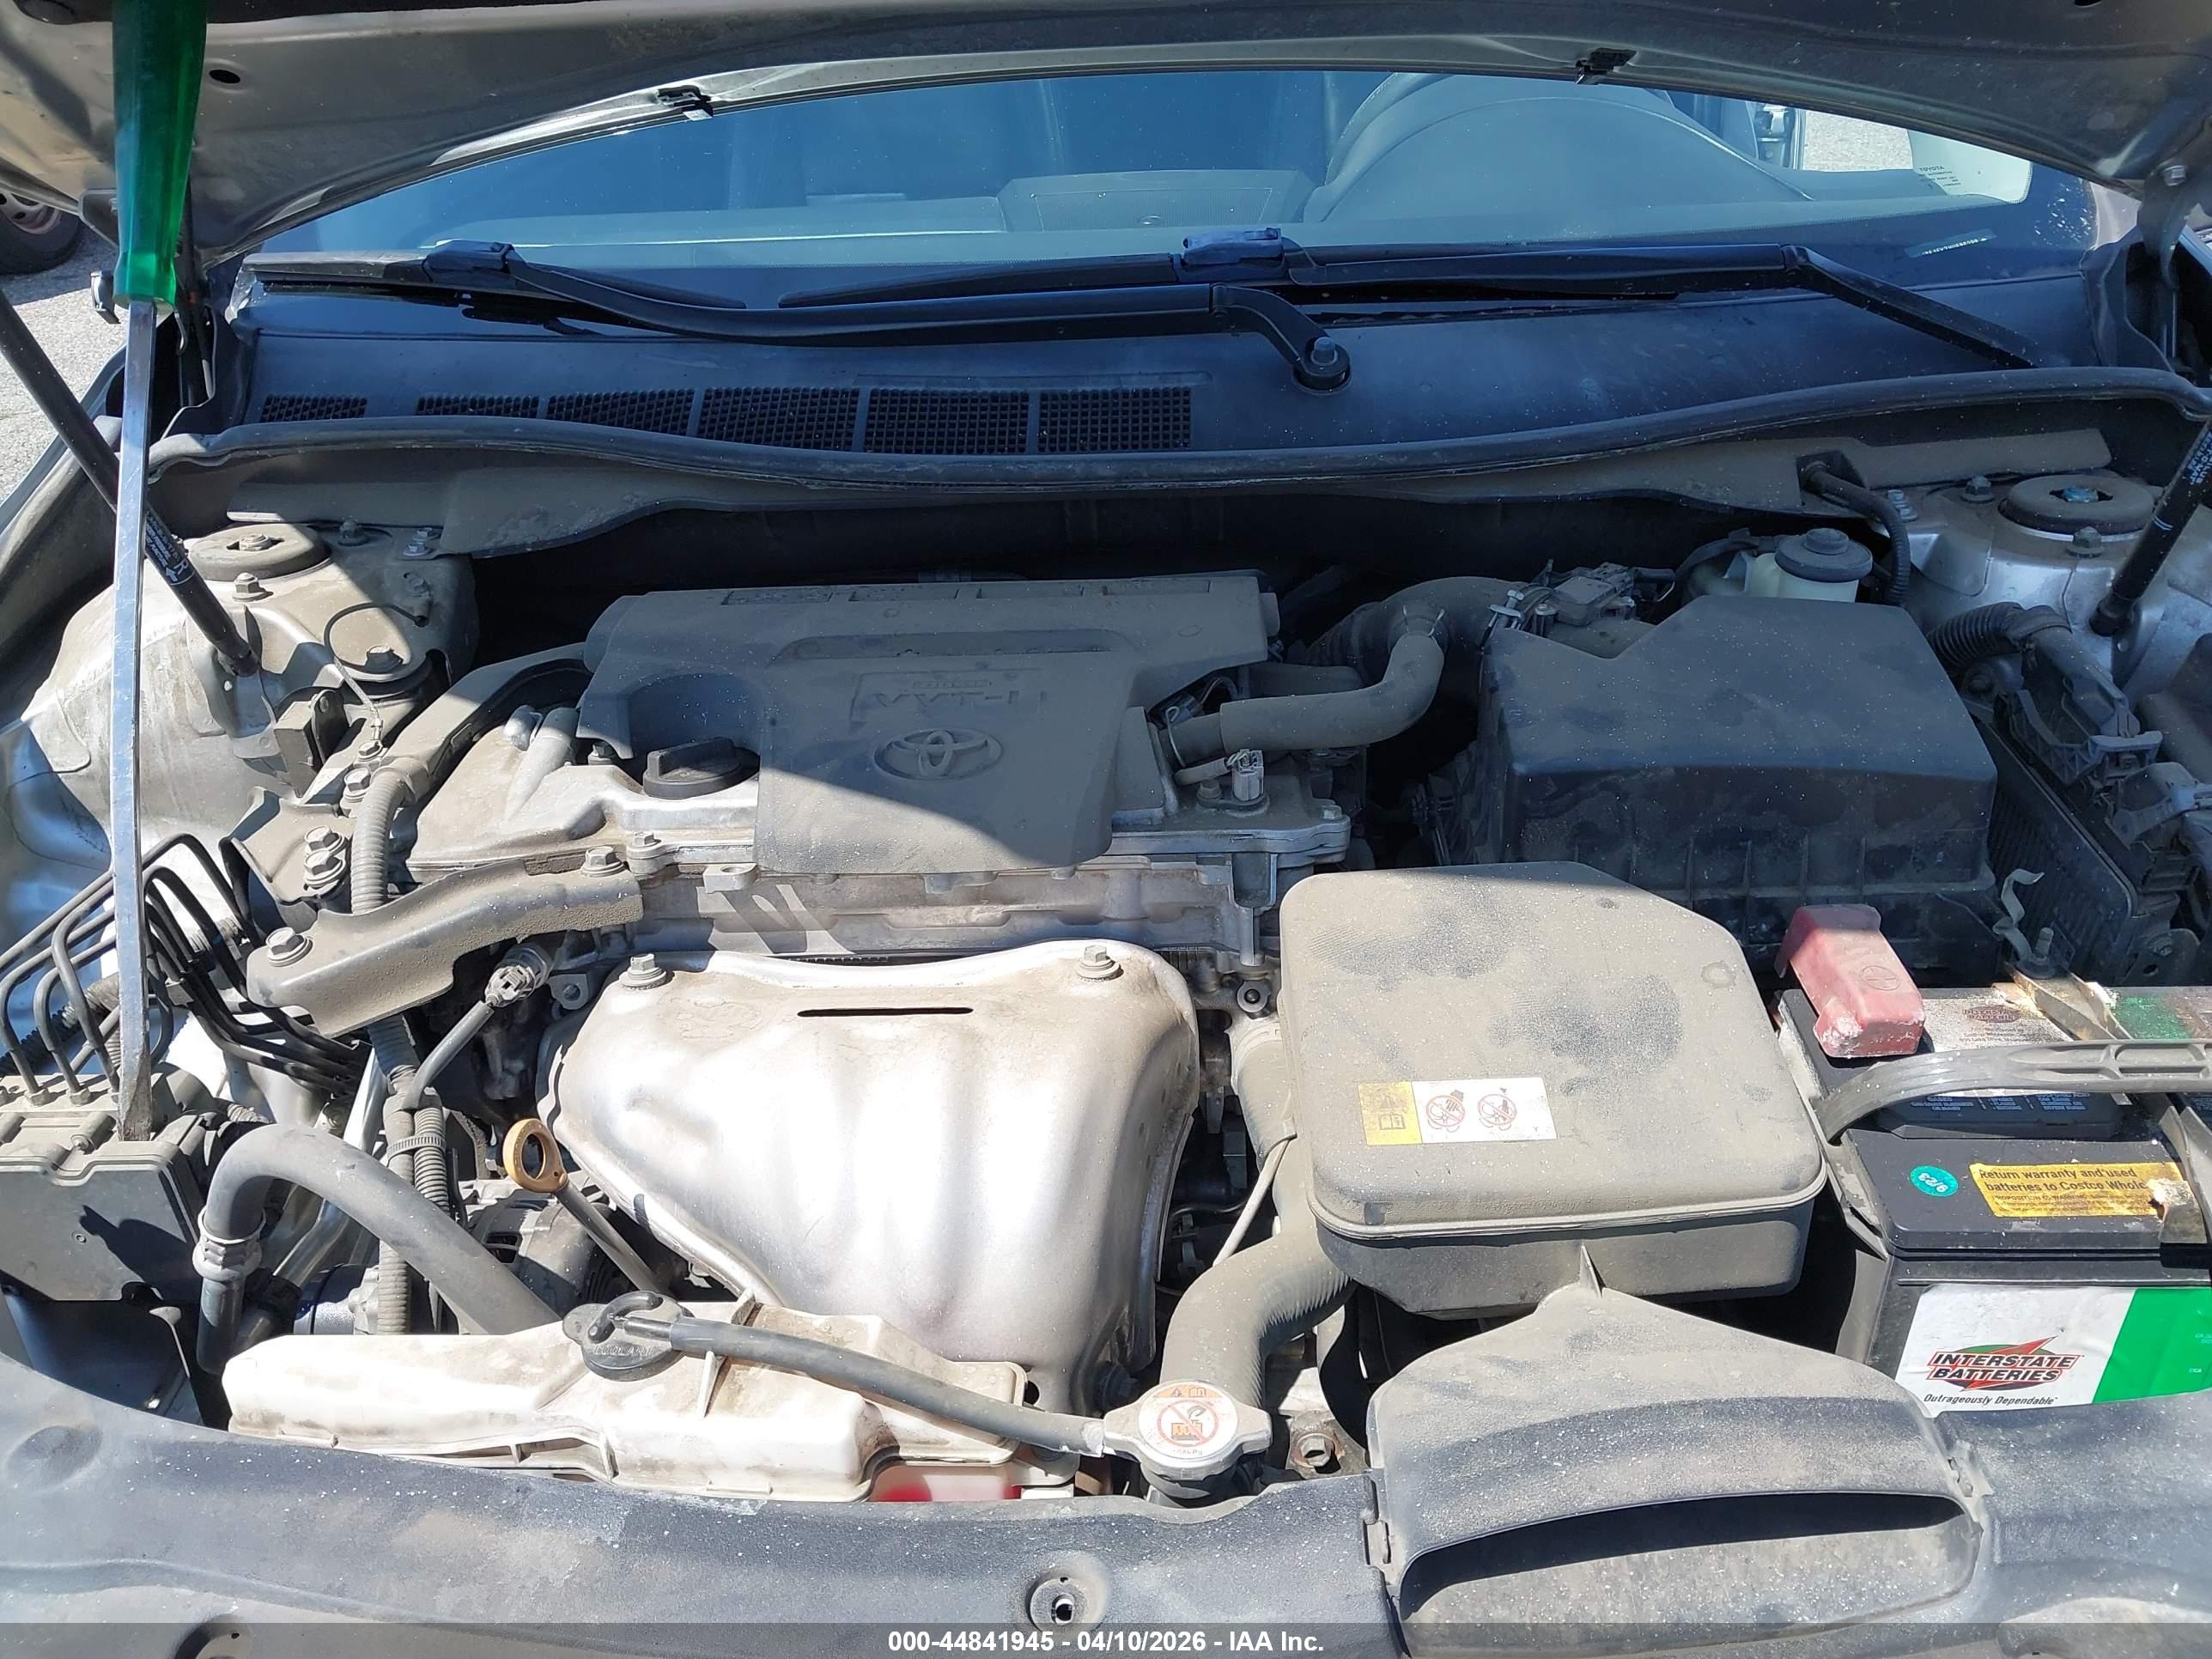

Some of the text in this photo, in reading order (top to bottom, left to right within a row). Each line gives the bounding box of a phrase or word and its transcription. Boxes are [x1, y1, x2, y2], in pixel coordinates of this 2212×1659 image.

[173, 558, 189, 574] R
[1980, 1168, 2137, 1181] Return warranty and used
[1985, 1182, 2041, 1191] batteries
[2045, 1182, 2058, 1191] to
[2060, 1182, 2104, 1191] Costco
[1933, 1353, 2080, 1369] INTERSTATE
[1930, 1367, 2060, 1381] BATTERIES
[1923, 1394, 2055, 1406] Outrageously Dependable
